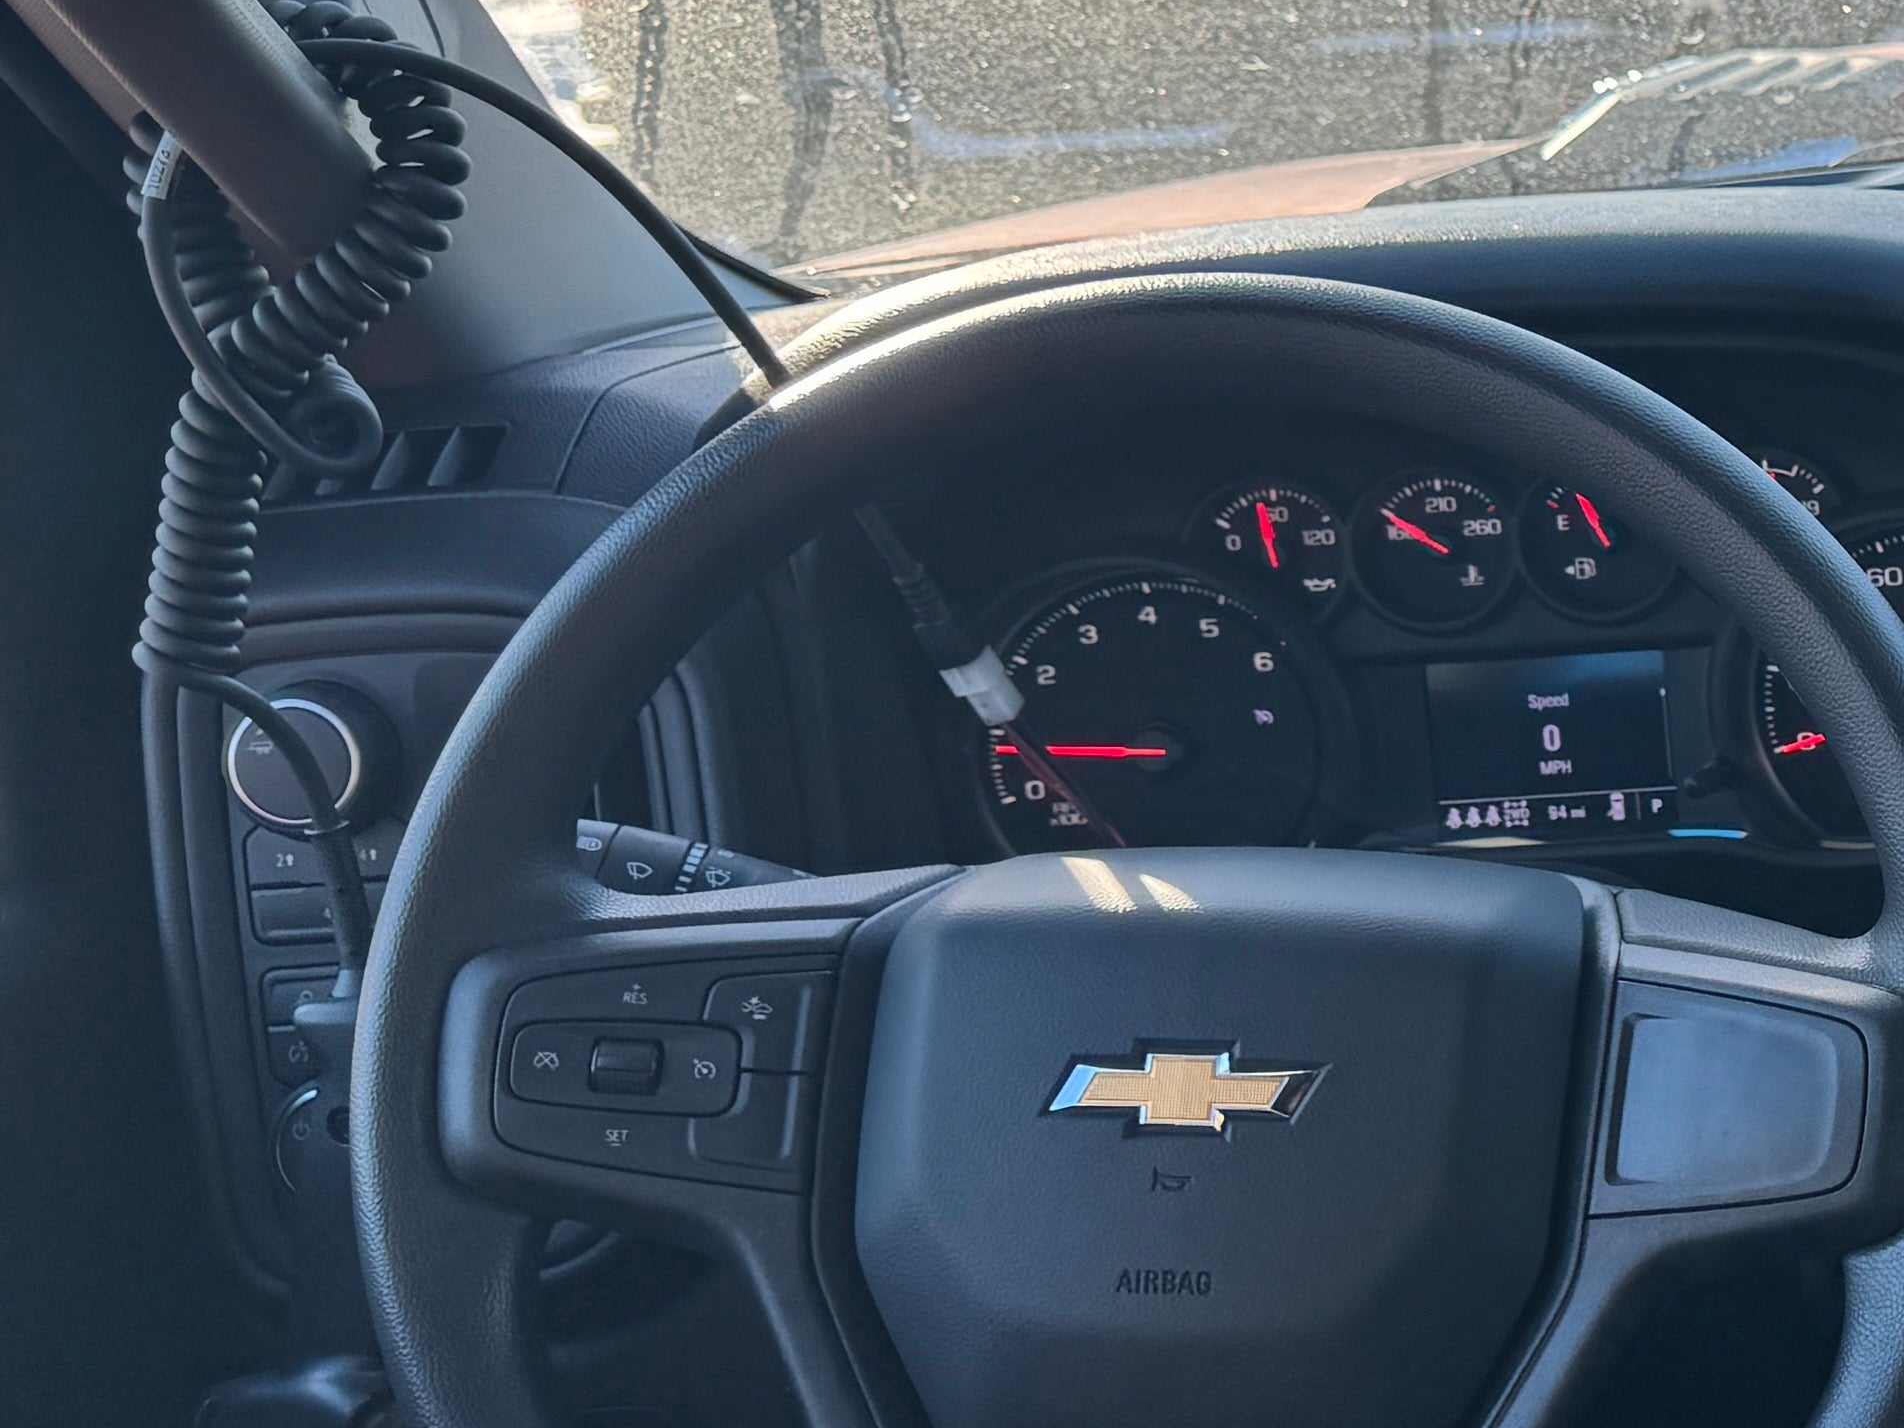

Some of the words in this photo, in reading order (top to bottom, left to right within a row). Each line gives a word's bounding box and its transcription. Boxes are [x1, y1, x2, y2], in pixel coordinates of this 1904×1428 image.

[1424, 496, 1457, 513] 210
[1462, 519, 1501, 536] 260
[1556, 514, 1570, 531] E
[1225, 534, 1242, 551] 0
[1302, 528, 1337, 546] 120
[1137, 606, 1158, 625] 4
[1078, 624, 1099, 645] 3
[1199, 618, 1220, 638] 5
[1253, 652, 1275, 673] 6
[1036, 664, 1057, 685] 2
[1528, 693, 1570, 711] Speed
[1542, 724, 1561, 752] 0
[1539, 759, 1572, 775] MPH
[1024, 779, 1046, 801] 0
[1651, 798, 1663, 813] P
[622, 991, 648, 1005] RES
[605, 1129, 629, 1143] SET
[1115, 1268, 1213, 1296] AIRBAG
